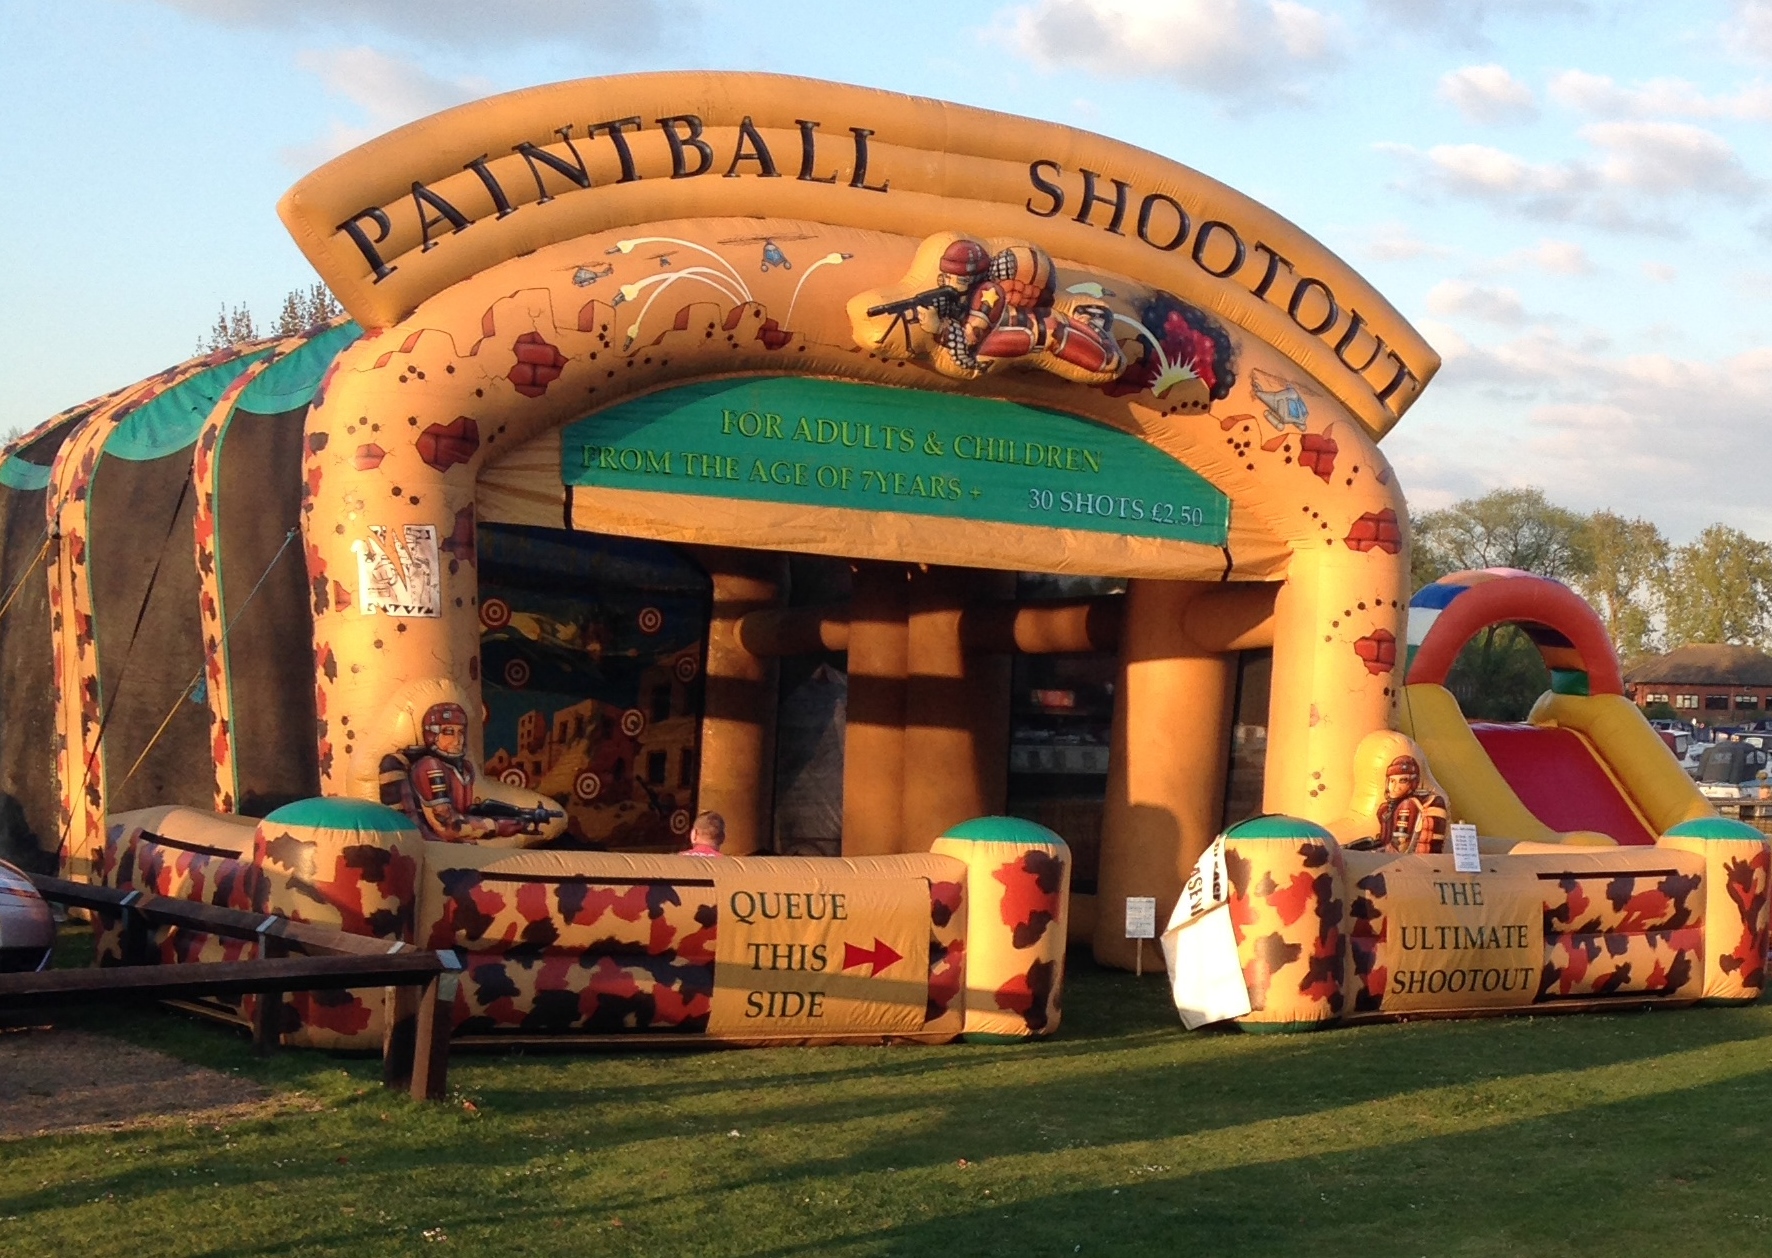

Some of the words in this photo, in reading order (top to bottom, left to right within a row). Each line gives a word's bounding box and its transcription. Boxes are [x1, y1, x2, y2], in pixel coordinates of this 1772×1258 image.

[336, 114, 890, 285] PAINTBALL
[1026, 159, 1420, 410] SHOOTOUT
[721, 408, 784, 440] FOR
[792, 416, 915, 452] ADULTS
[923, 430, 945, 457] &
[954, 435, 1101, 473] CHILDREN
[582, 443, 673, 475] FROM
[681, 451, 740, 480] THE
[749, 458, 809, 487] AGE
[816, 464, 853, 490] OF
[1028, 488, 1053, 511] 30
[1060, 490, 1144, 521] SHOTS
[1150, 501, 1203, 528] £2.50
[730, 890, 848, 925] QUEUE
[1433, 881, 1484, 906] THE
[1401, 924, 1529, 951] ULTIMATE
[747, 942, 827, 972] THIS
[1391, 967, 1535, 995] SHOOTOUT
[745, 990, 825, 1018] SIDE
